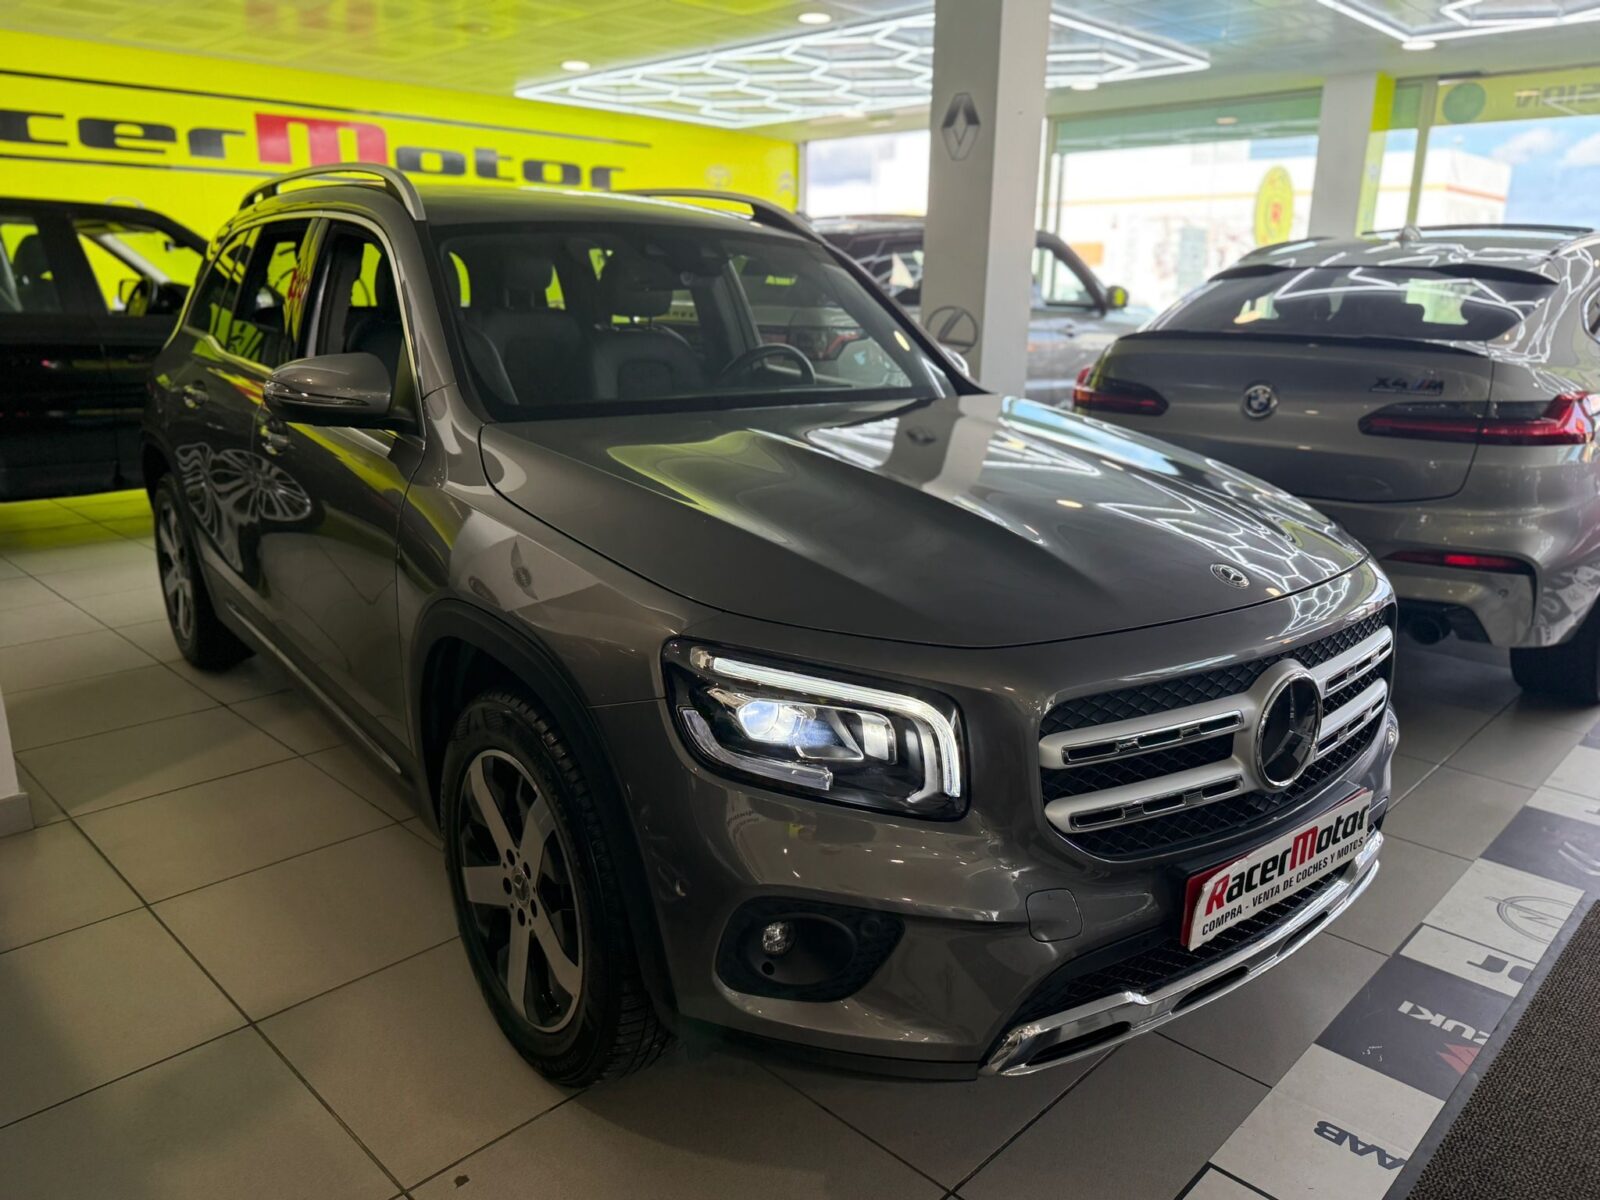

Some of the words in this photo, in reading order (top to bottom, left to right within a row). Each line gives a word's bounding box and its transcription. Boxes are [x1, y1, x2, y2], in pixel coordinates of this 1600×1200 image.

[1202, 904, 1242, 936] COMPRA
[1252, 884, 1280, 907] VENTA
[1283, 876, 1294, 891] DE
[1296, 856, 1328, 883] COCHES
[1330, 852, 1335, 863] Y
[1337, 836, 1364, 860] MOTOS
